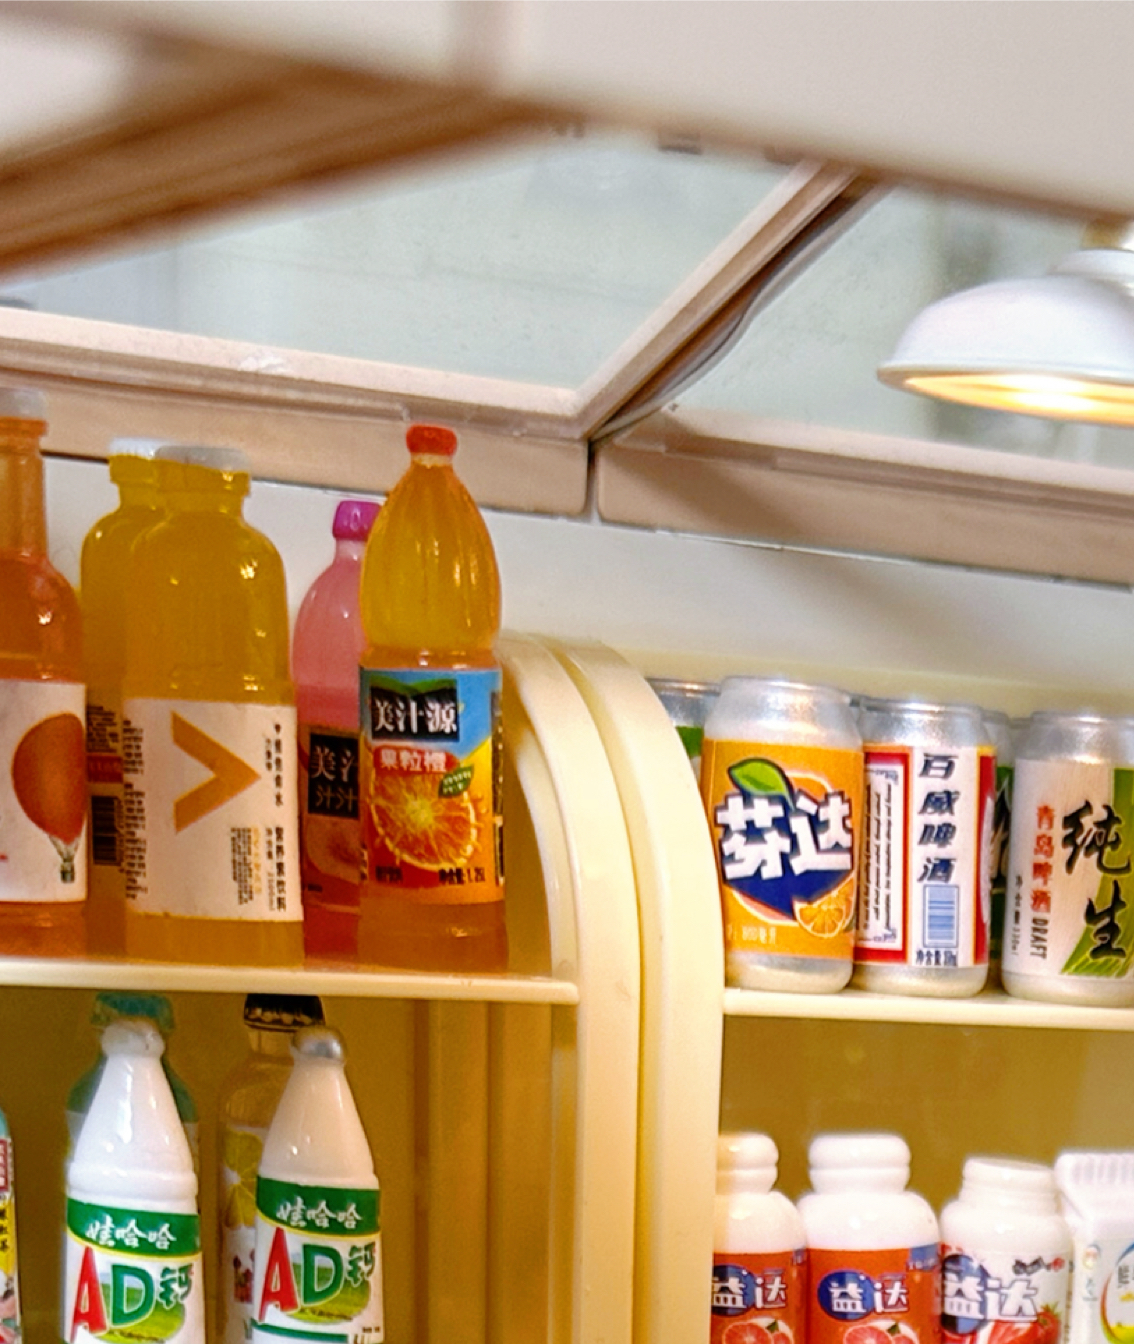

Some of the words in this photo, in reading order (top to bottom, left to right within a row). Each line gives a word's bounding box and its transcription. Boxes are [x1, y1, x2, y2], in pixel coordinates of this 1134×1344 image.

[374, 699, 457, 734] 美汁源
[381, 748, 447, 772] 果粒橙
[714, 788, 853, 882] 芬达
[917, 752, 960, 884] 百威啤酒
[1031, 805, 1056, 914] 青岛啤酒
[1061, 798, 1133, 960] 纯生
[1030, 916, 1050, 960] DRAFT
[85, 1213, 177, 1249] 娃哈哈
[275, 1194, 362, 1229] 娃哈哈
[712, 1274, 787, 1310] 益达
[829, 1278, 909, 1313] 益达
[943, 1271, 1038, 1322] 益达
